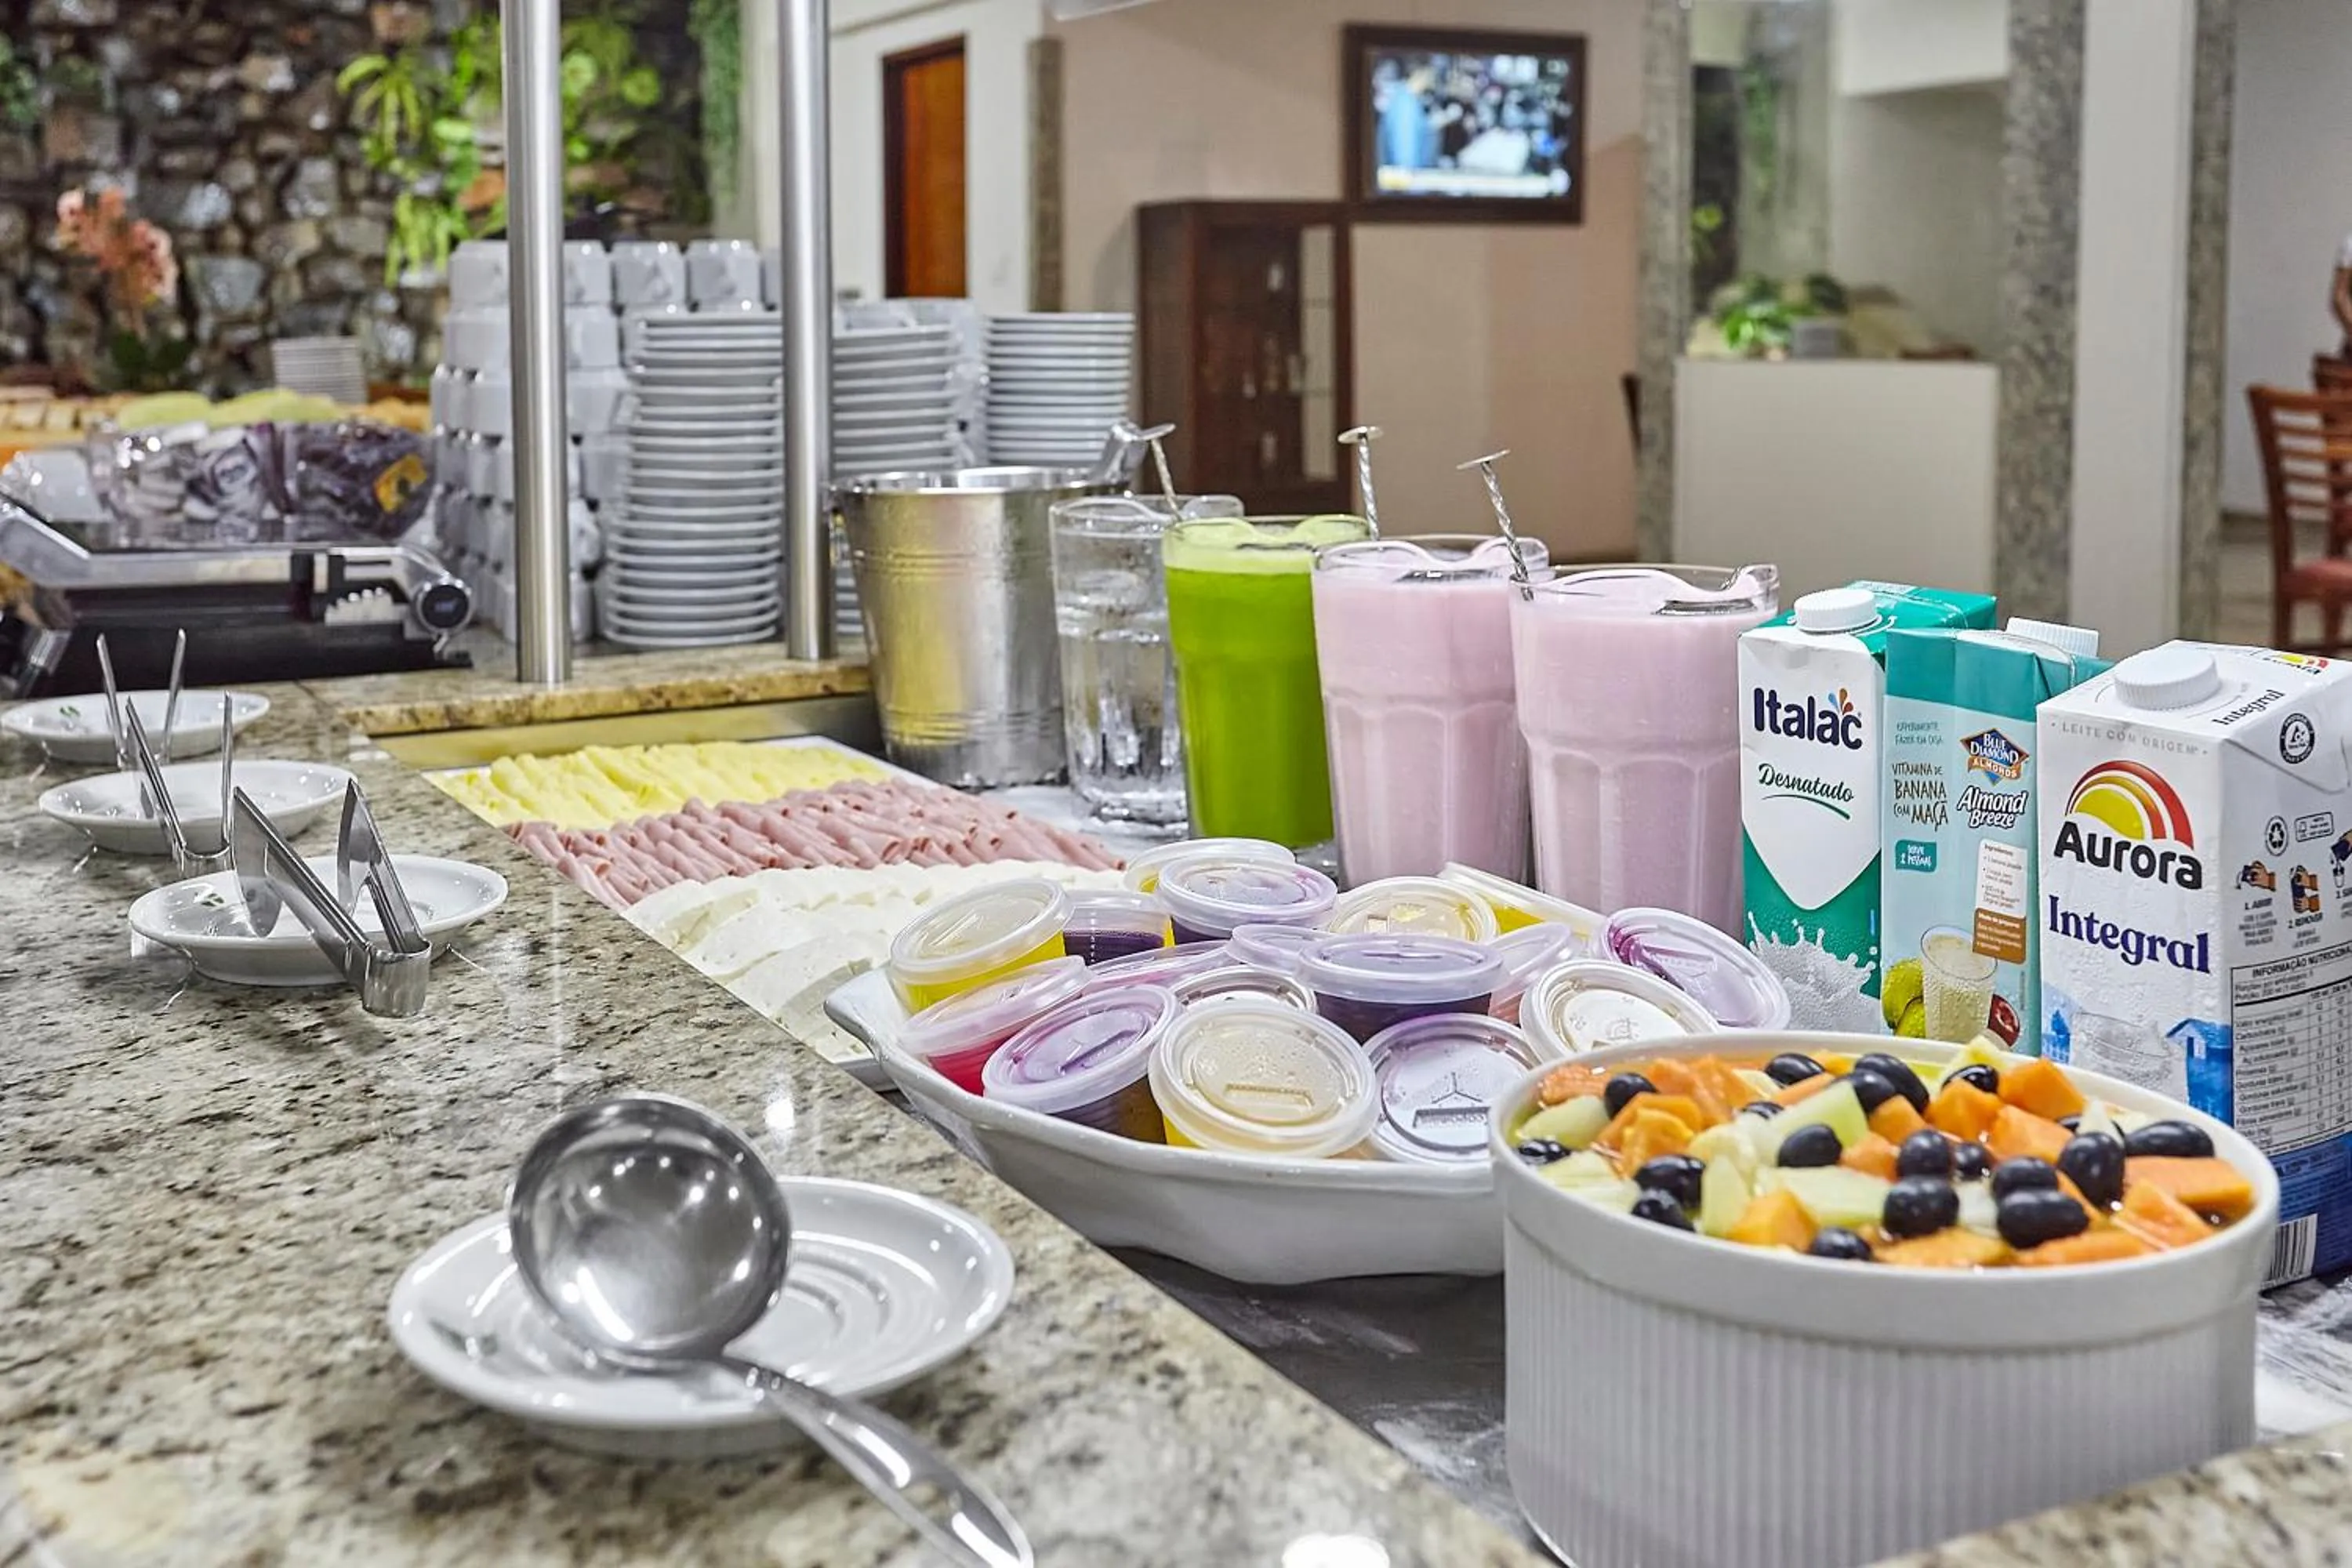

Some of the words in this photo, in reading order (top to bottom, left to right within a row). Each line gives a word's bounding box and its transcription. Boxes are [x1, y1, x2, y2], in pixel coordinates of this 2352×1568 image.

[1753, 687, 1864, 750] Italac
[1984, 733, 2008, 750] BLUE
[2062, 720, 2101, 739] LEITE
[2106, 728, 2137, 743] COM
[1969, 740, 2020, 764] DIAMOND
[1892, 761, 1933, 776] VITAMINA
[1972, 757, 2018, 779] ALMONDS
[1758, 763, 1855, 803] Desnatado
[1893, 779, 1947, 800] BANANA
[1957, 785, 2030, 815] Almond
[1893, 802, 1911, 818] COM
[1911, 800, 1948, 833] MAÇÃ
[1967, 808, 2016, 829] Breeze
[2053, 820, 2204, 891] Aurora
[2048, 894, 2212, 975] Integral
